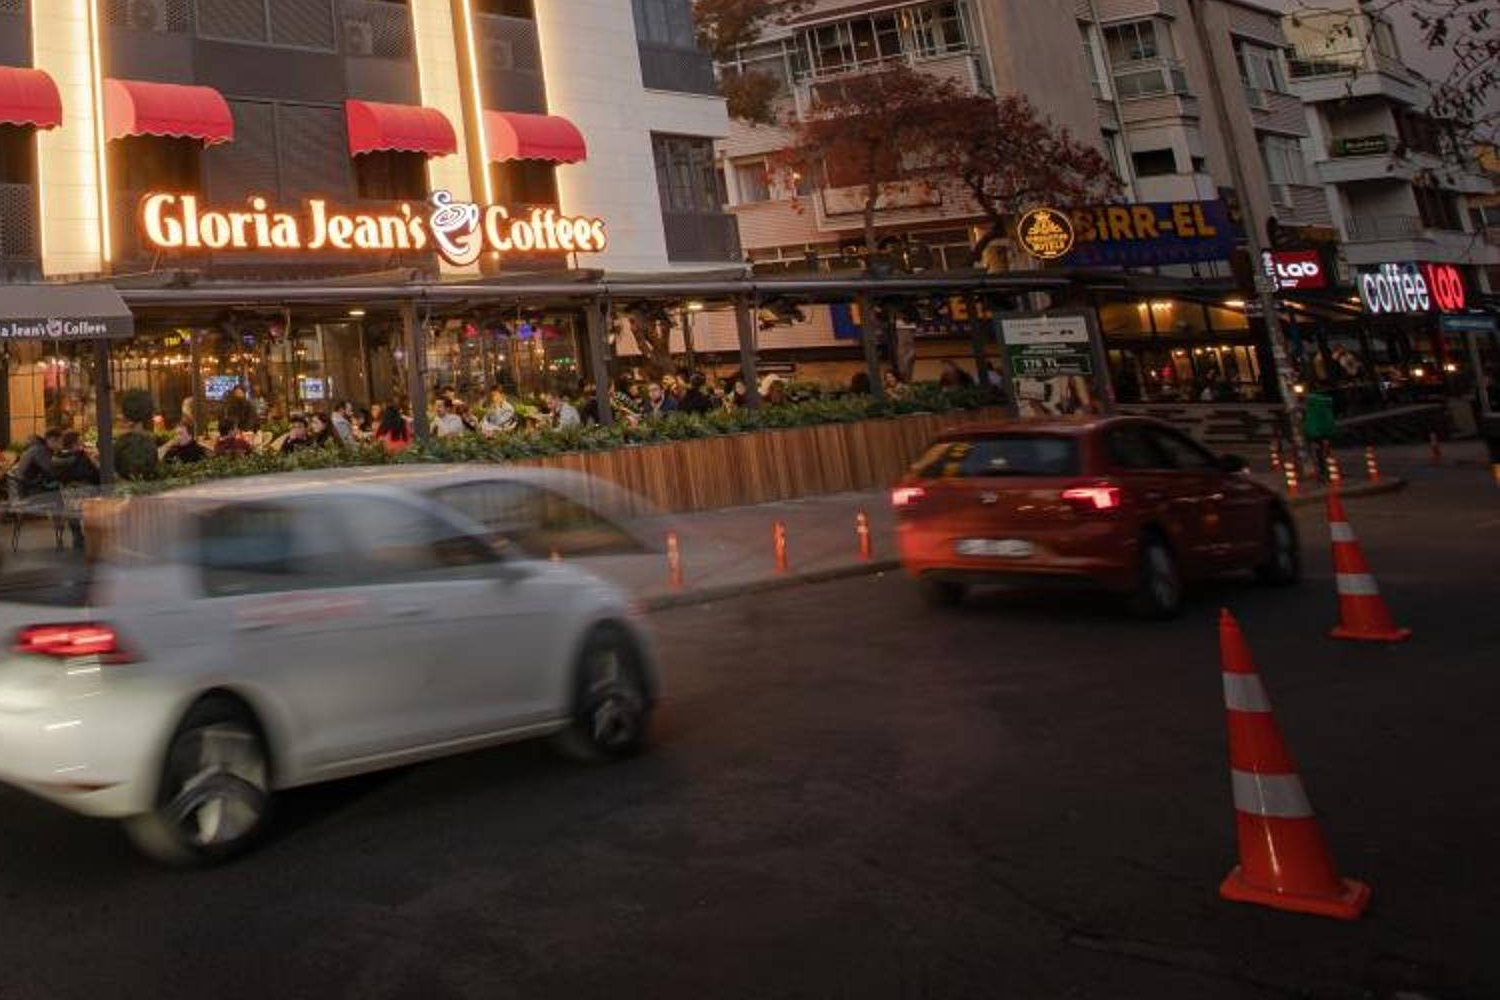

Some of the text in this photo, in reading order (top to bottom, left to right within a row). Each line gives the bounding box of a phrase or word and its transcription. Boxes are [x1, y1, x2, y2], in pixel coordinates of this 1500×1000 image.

[144, 193, 606, 251] Gloria Jean's Coffees
[1363, 263, 1430, 313] coffee
